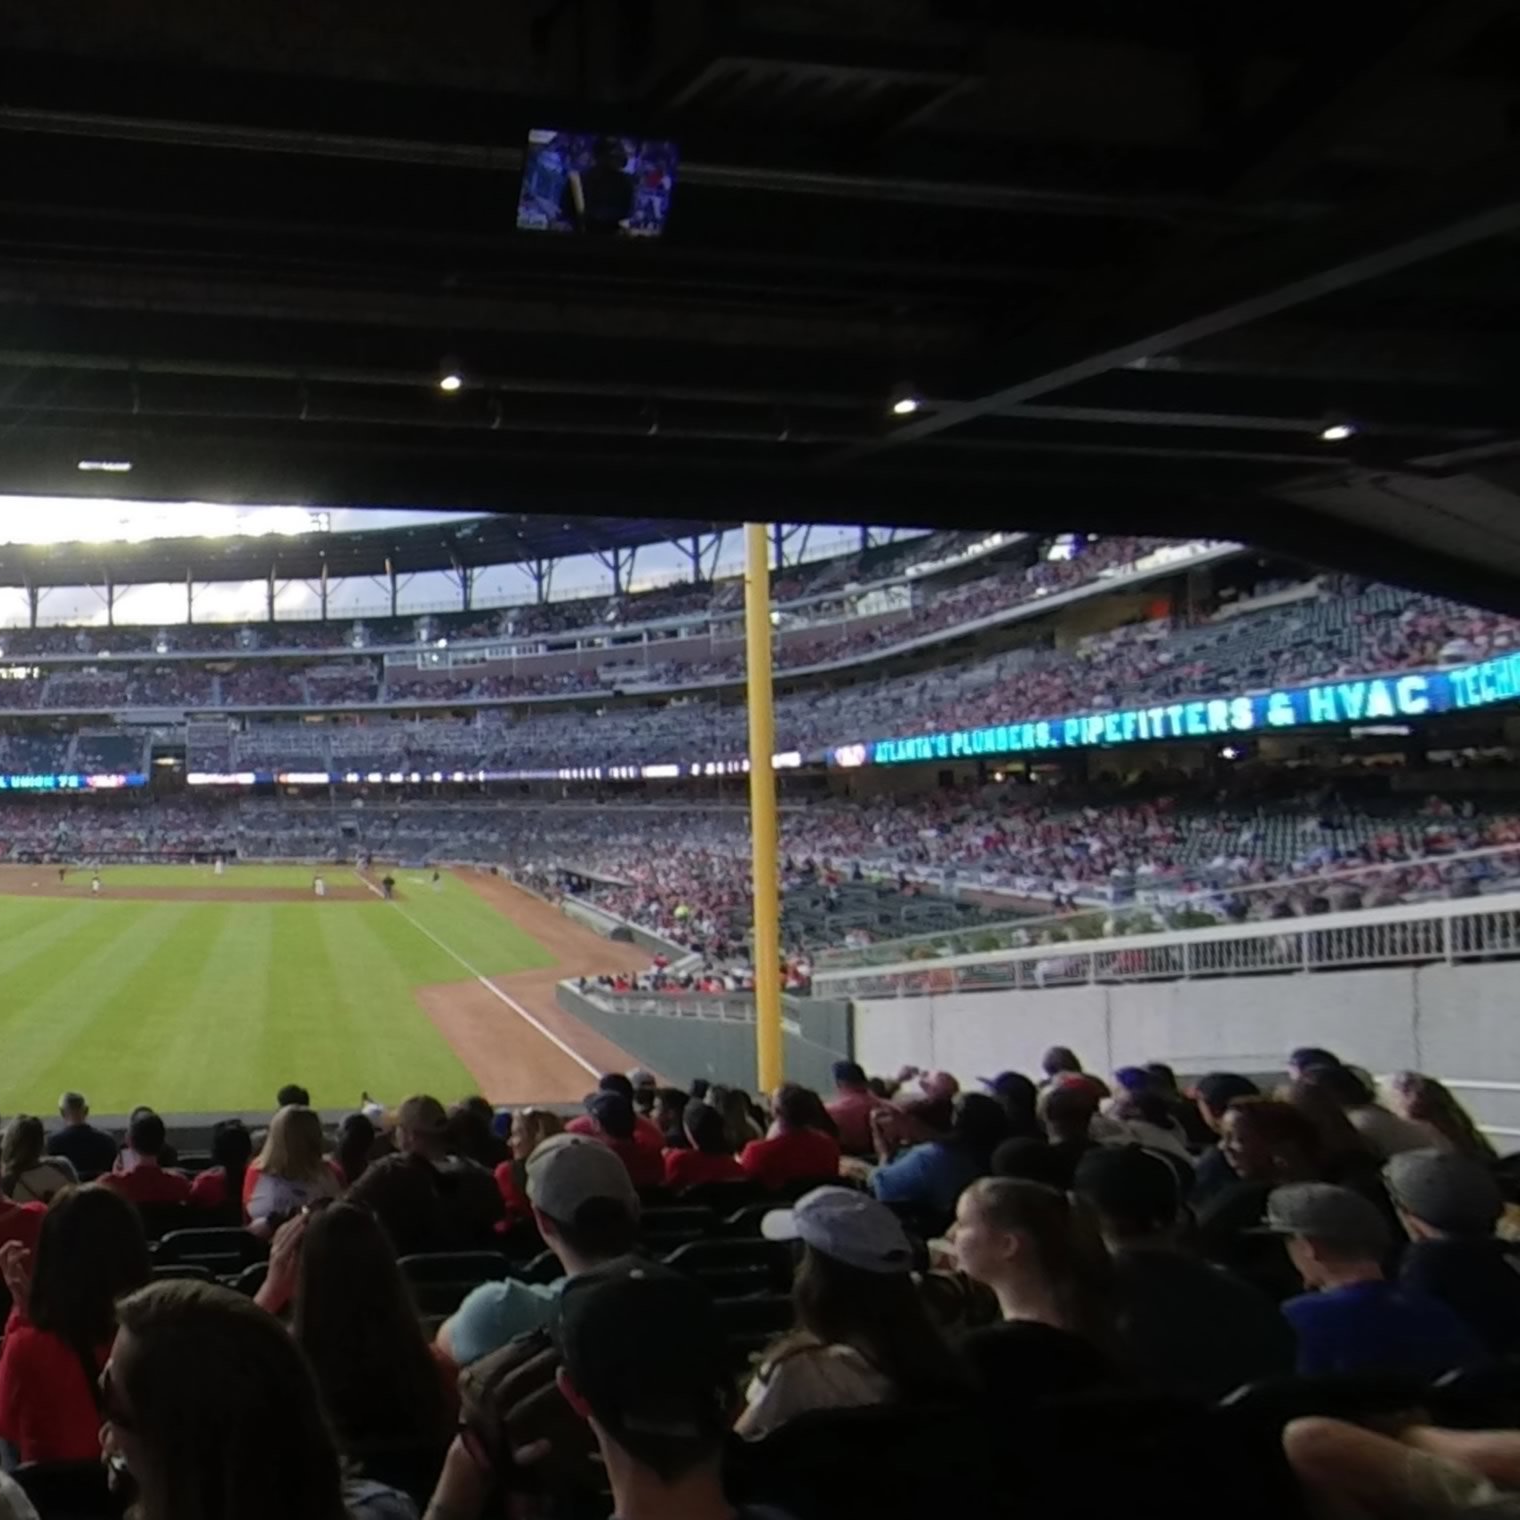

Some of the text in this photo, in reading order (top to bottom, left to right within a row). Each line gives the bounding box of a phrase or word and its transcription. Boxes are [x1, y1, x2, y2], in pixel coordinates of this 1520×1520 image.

[875, 734, 947, 763] ATLANTA'S
[1065, 697, 1254, 747] PIPEFITTERS
[1268, 692, 1295, 726] &
[1309, 675, 1430, 723] HVAC
[10, 775, 55, 788] UNION
